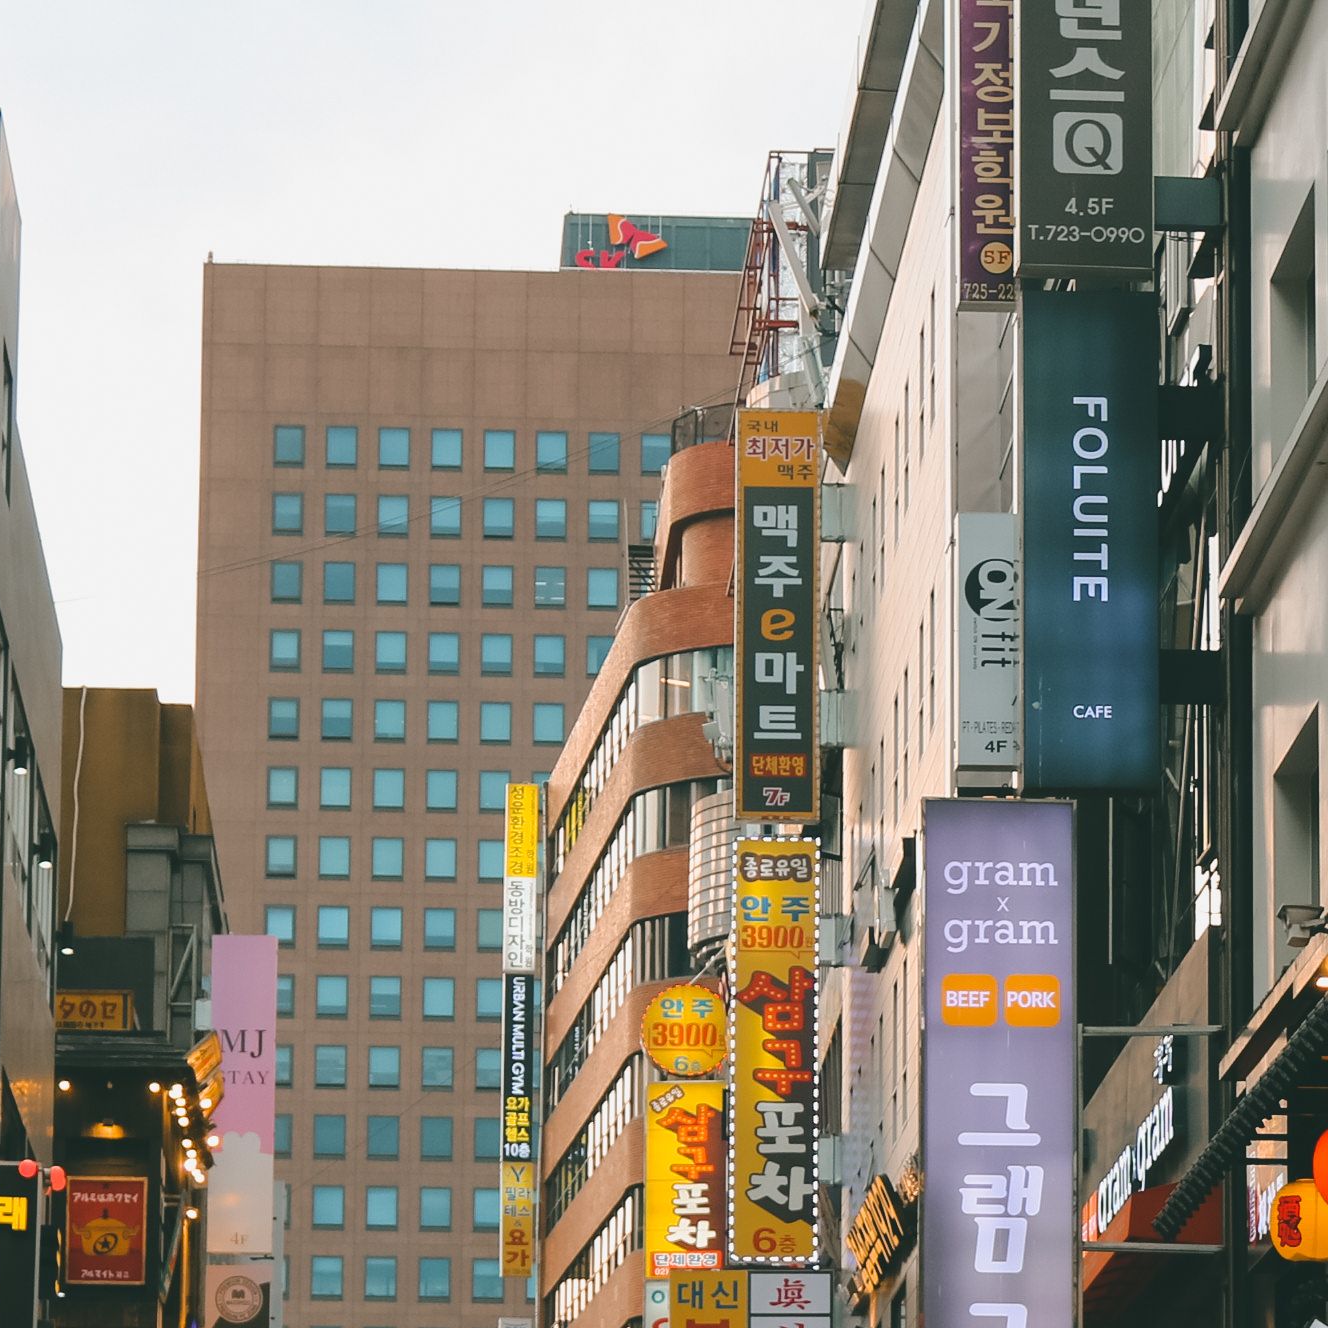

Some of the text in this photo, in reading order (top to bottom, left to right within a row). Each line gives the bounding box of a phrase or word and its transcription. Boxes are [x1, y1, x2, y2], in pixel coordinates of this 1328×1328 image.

[1065, 198, 1114, 216] 4.5F
[1028, 225, 1145, 243] T.723-0990
[984, 251, 1012, 264] 5F
[747, 419, 778, 433] 국내
[746, 437, 814, 461] 최저가
[777, 463, 814, 480] 맥주
[1073, 396, 1109, 602] FOLUITE
[1073, 705, 1113, 720] CAFE
[985, 741, 1007, 753] 4F
[762, 787, 790, 806] 7F
[743, 855, 810, 881] 종로유일
[944, 860, 1058, 894] gram
[741, 895, 810, 923] 안주
[944, 919, 1058, 953] gram
[660, 997, 715, 1019] 안주
[946, 990, 1056, 1008] BEEF PORK
[221, 1029, 267, 1058] MJ
[512, 976, 525, 1096] URBAN MULTI GYM
[505, 1097, 530, 1111] 요가
[505, 1112, 530, 1127] 골프
[504, 1142, 530, 1158] 10층
[752, 1227, 798, 1255] 6층
[677, 1280, 738, 1310] 대신
